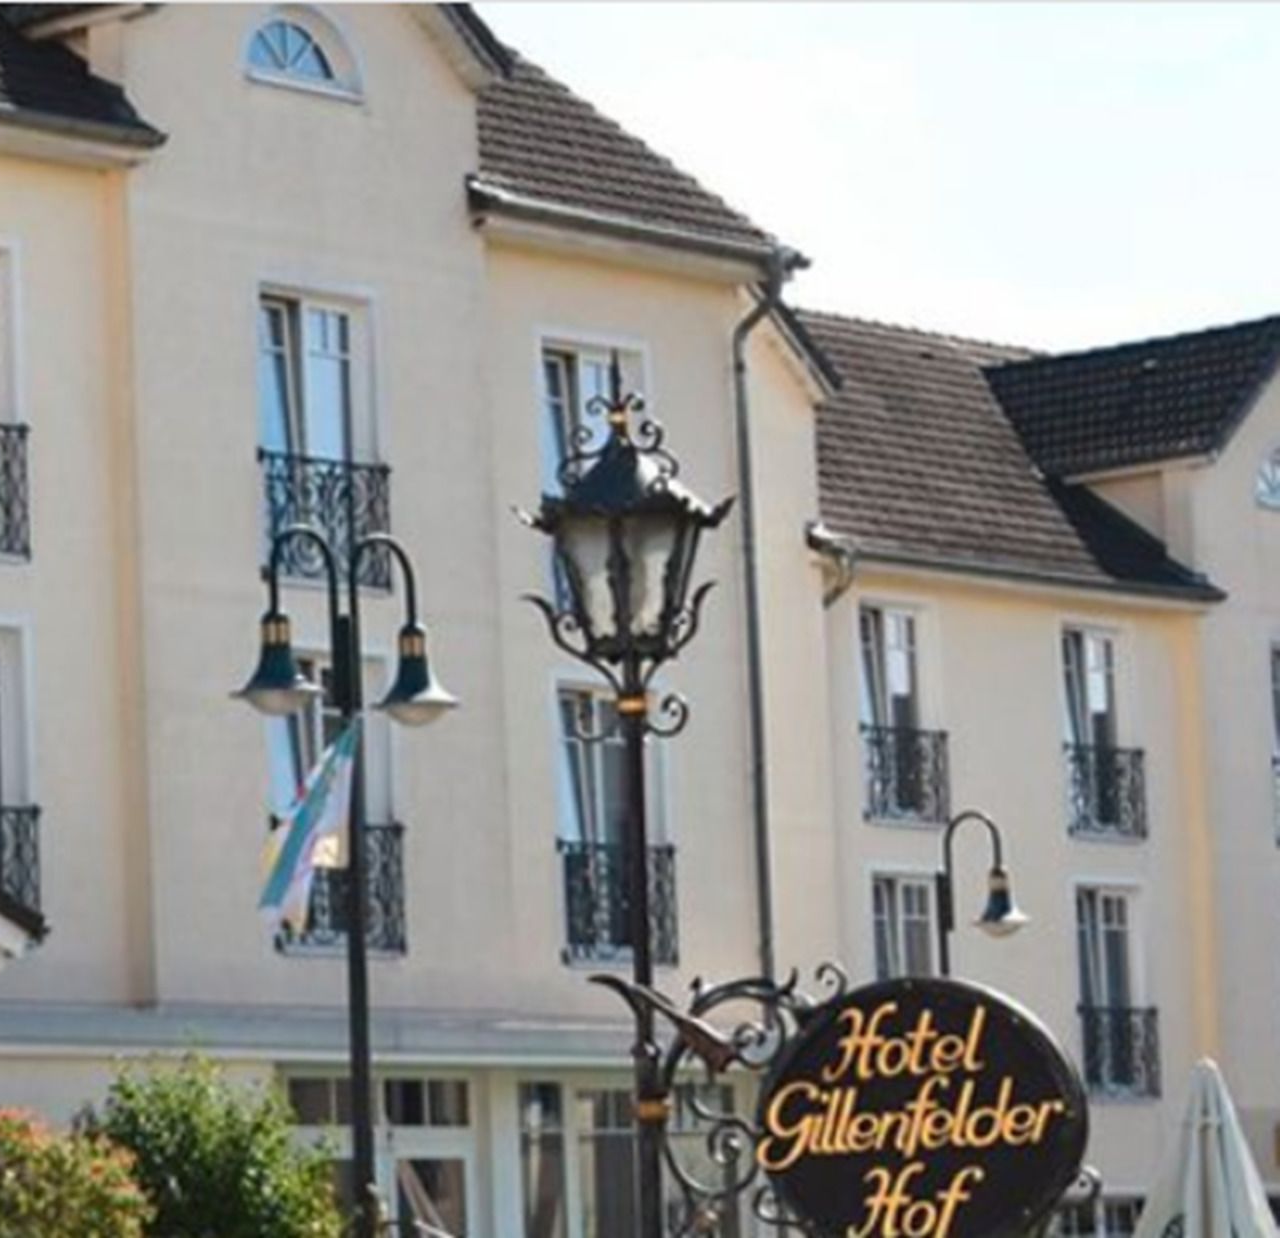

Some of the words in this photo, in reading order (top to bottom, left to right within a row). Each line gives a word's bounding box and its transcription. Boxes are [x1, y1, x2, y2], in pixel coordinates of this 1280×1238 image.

[822, 1002, 986, 1082] Hotel
[756, 1076, 1065, 1171] Gillenfelder
[847, 1162, 985, 1238] Hof
